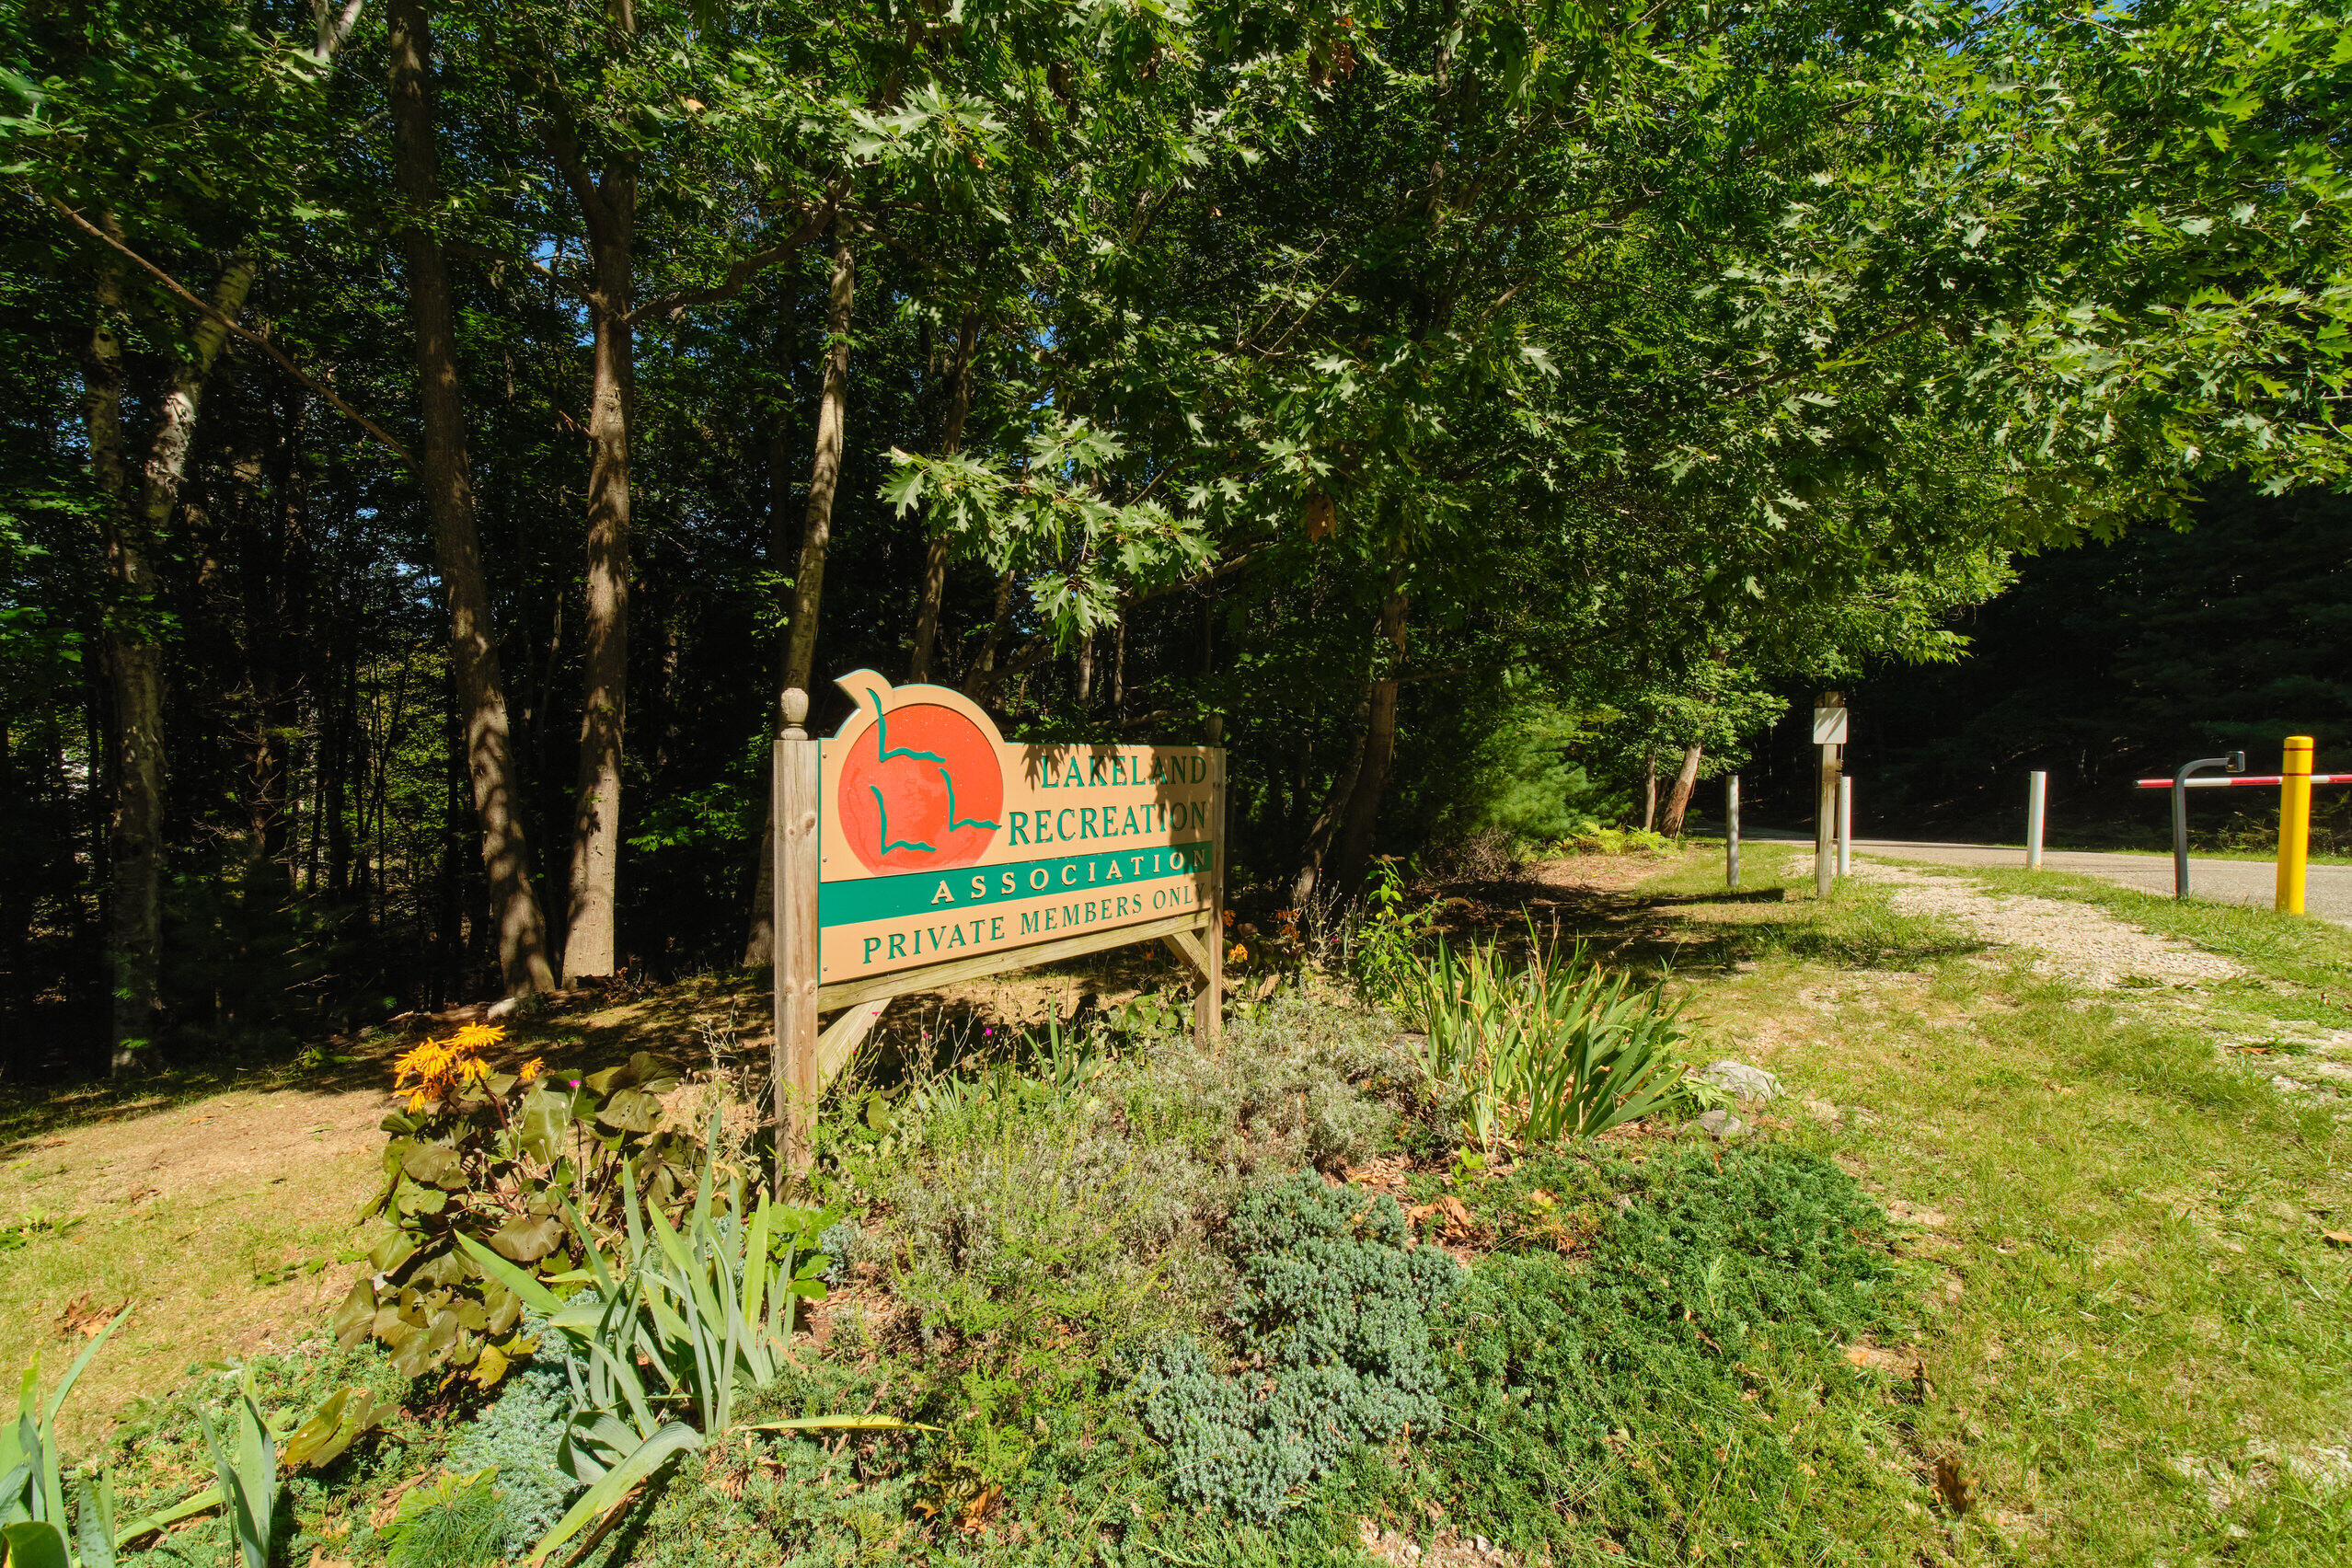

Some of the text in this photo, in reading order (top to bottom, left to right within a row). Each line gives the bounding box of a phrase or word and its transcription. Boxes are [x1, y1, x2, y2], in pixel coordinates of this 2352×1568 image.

[1041, 755, 1207, 789] LAKELAND
[1009, 801, 1206, 847] RECREATION
[930, 848, 1205, 905] ASSOCIATION
[862, 882, 1205, 964] PRIVATE MEMBERS ONLY
